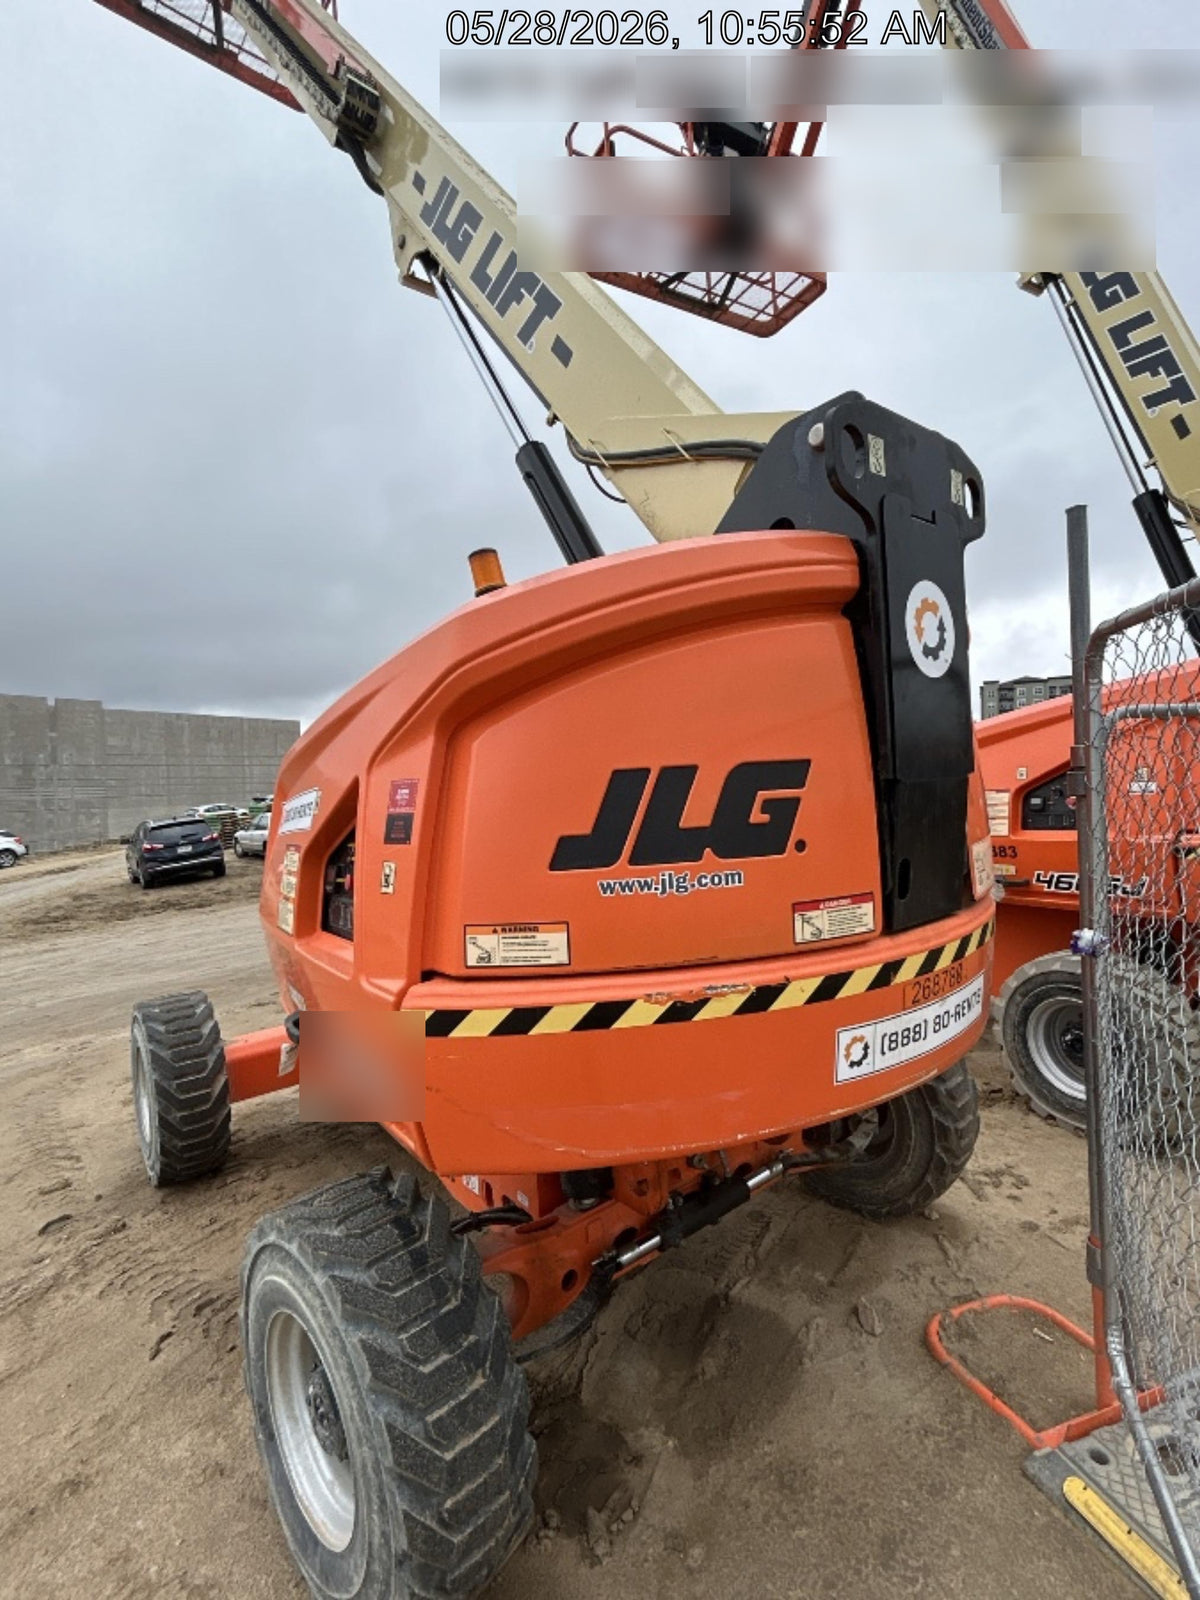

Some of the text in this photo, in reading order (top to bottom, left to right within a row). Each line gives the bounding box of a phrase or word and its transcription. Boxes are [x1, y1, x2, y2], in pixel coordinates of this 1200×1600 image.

[419, 176, 562, 348] JLG LIFT
[1106, 309, 1198, 412] LIFT
[549, 758, 811, 872] JLG
[597, 871, 744, 897] www.jlg.com
[880, 1018, 928, 1057] (888)
